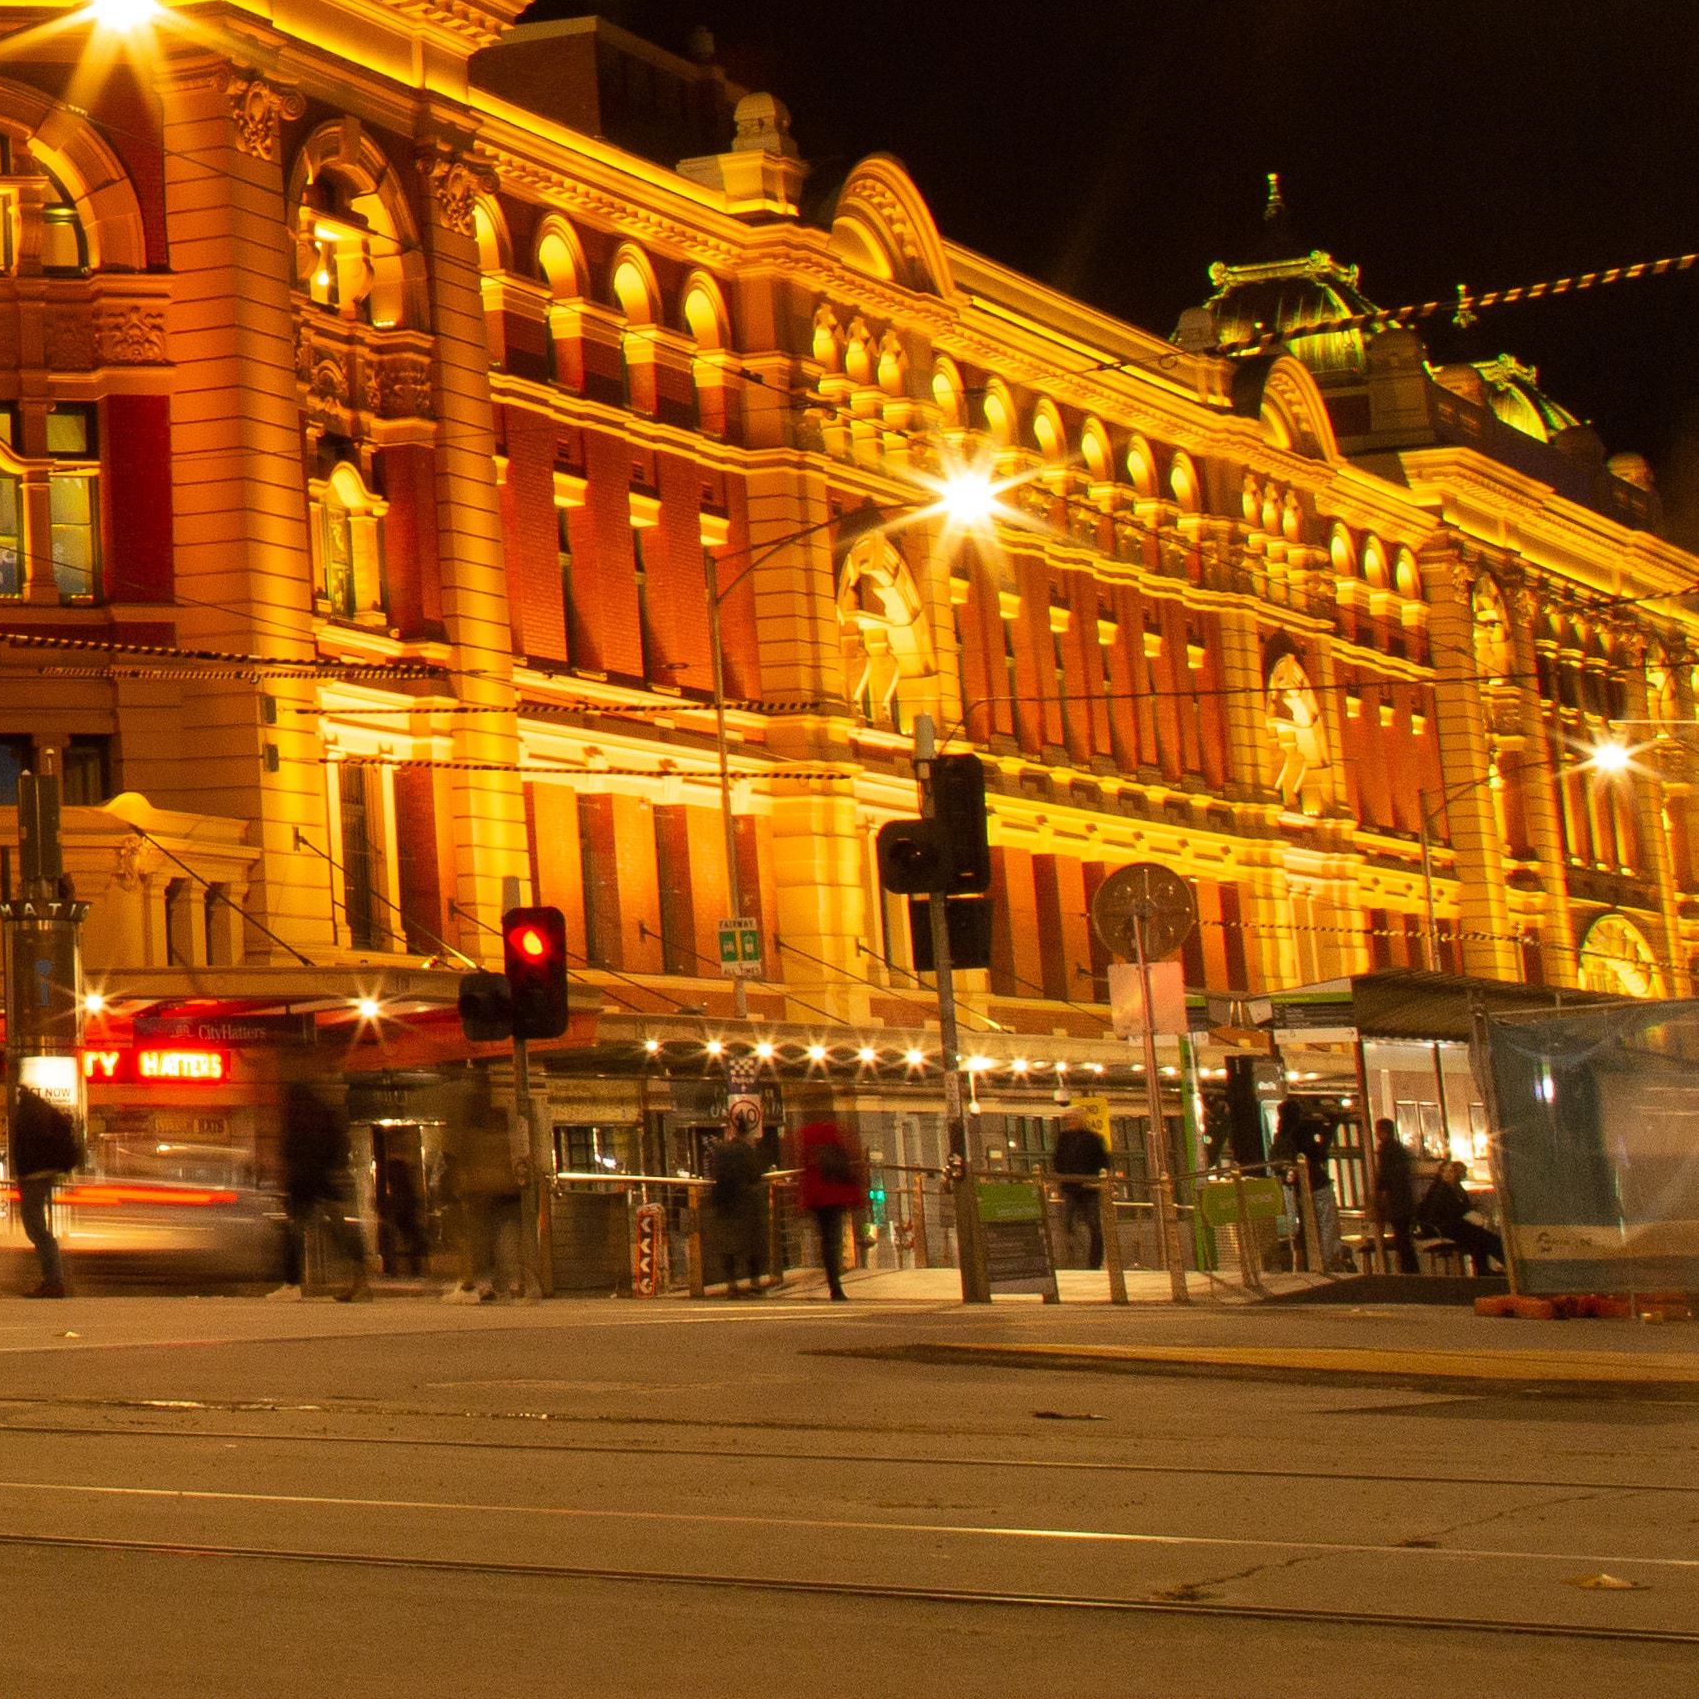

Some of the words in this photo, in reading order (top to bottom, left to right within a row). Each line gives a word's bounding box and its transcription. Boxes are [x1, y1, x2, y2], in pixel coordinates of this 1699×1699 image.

[720, 919, 754, 929] FAIRWAY
[198, 1024, 267, 1041] CityHatters
[139, 1051, 223, 1078] HATTERS
[45, 1087, 71, 1097] NOW
